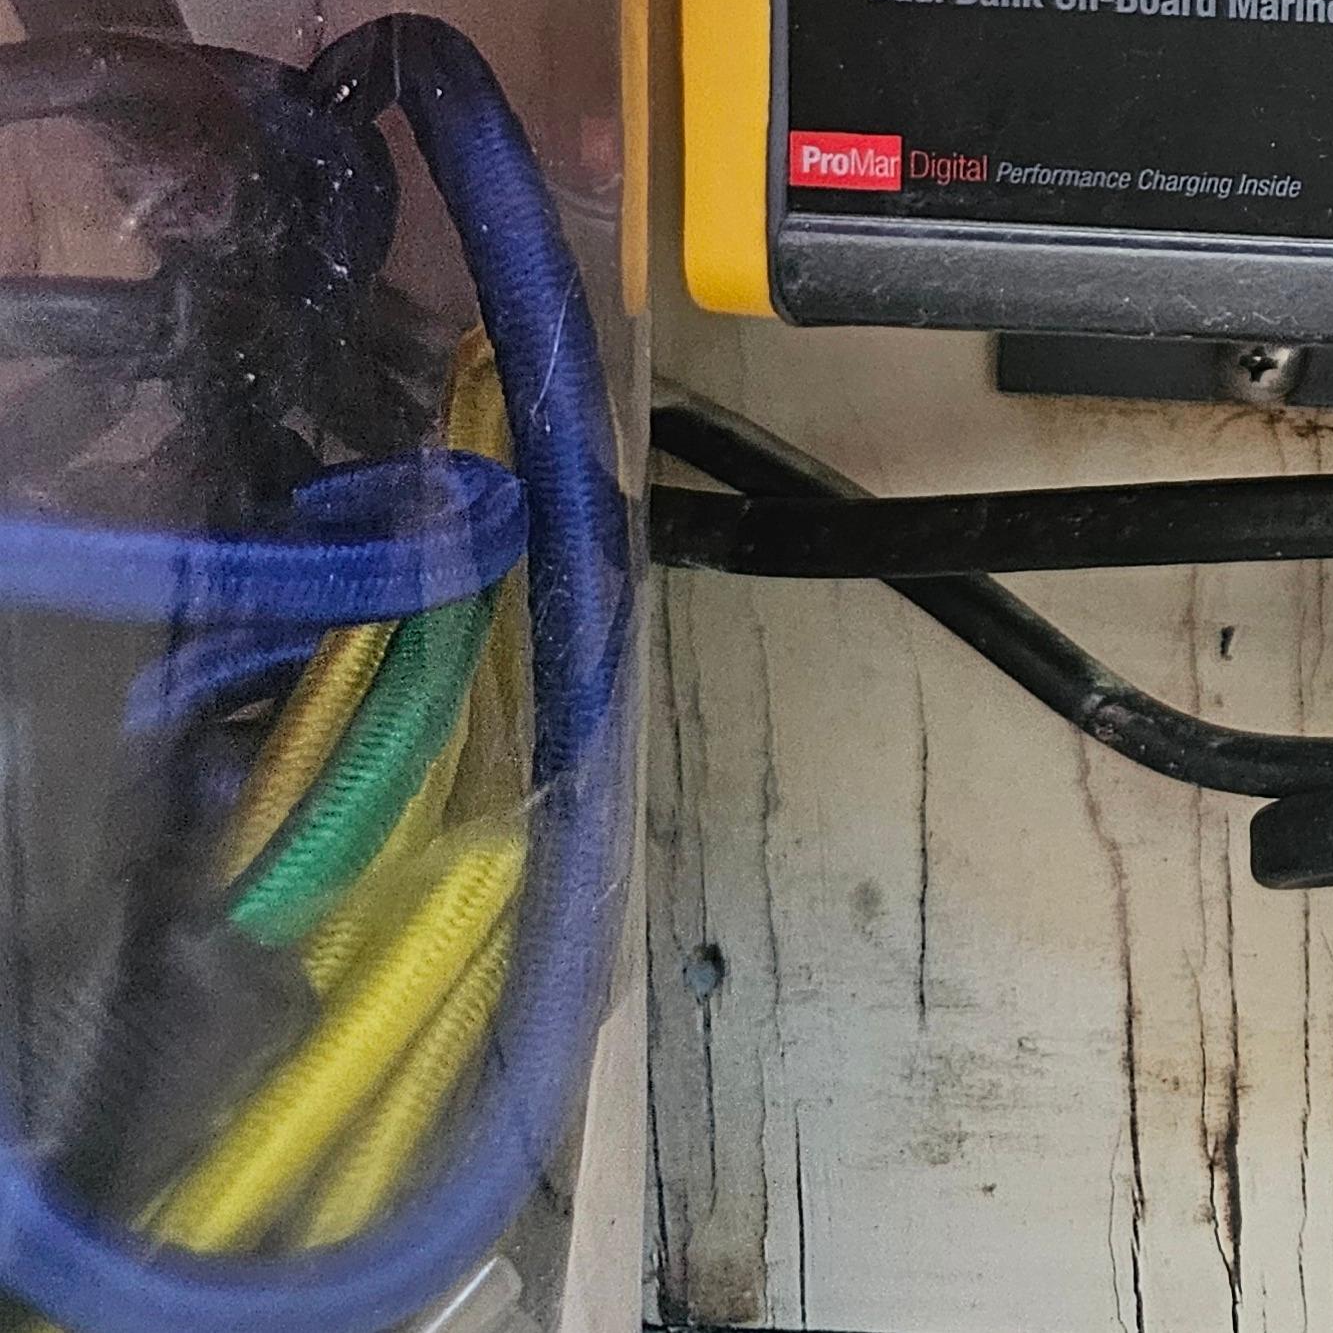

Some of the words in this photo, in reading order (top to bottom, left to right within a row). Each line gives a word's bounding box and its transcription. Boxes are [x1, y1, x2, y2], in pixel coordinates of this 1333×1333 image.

[802, 146, 901, 178] ProMar
[910, 150, 988, 186] Digital
[996, 161, 1132, 190] Performance
[1138, 168, 1233, 196] Charging
[1237, 173, 1302, 198] Inside
